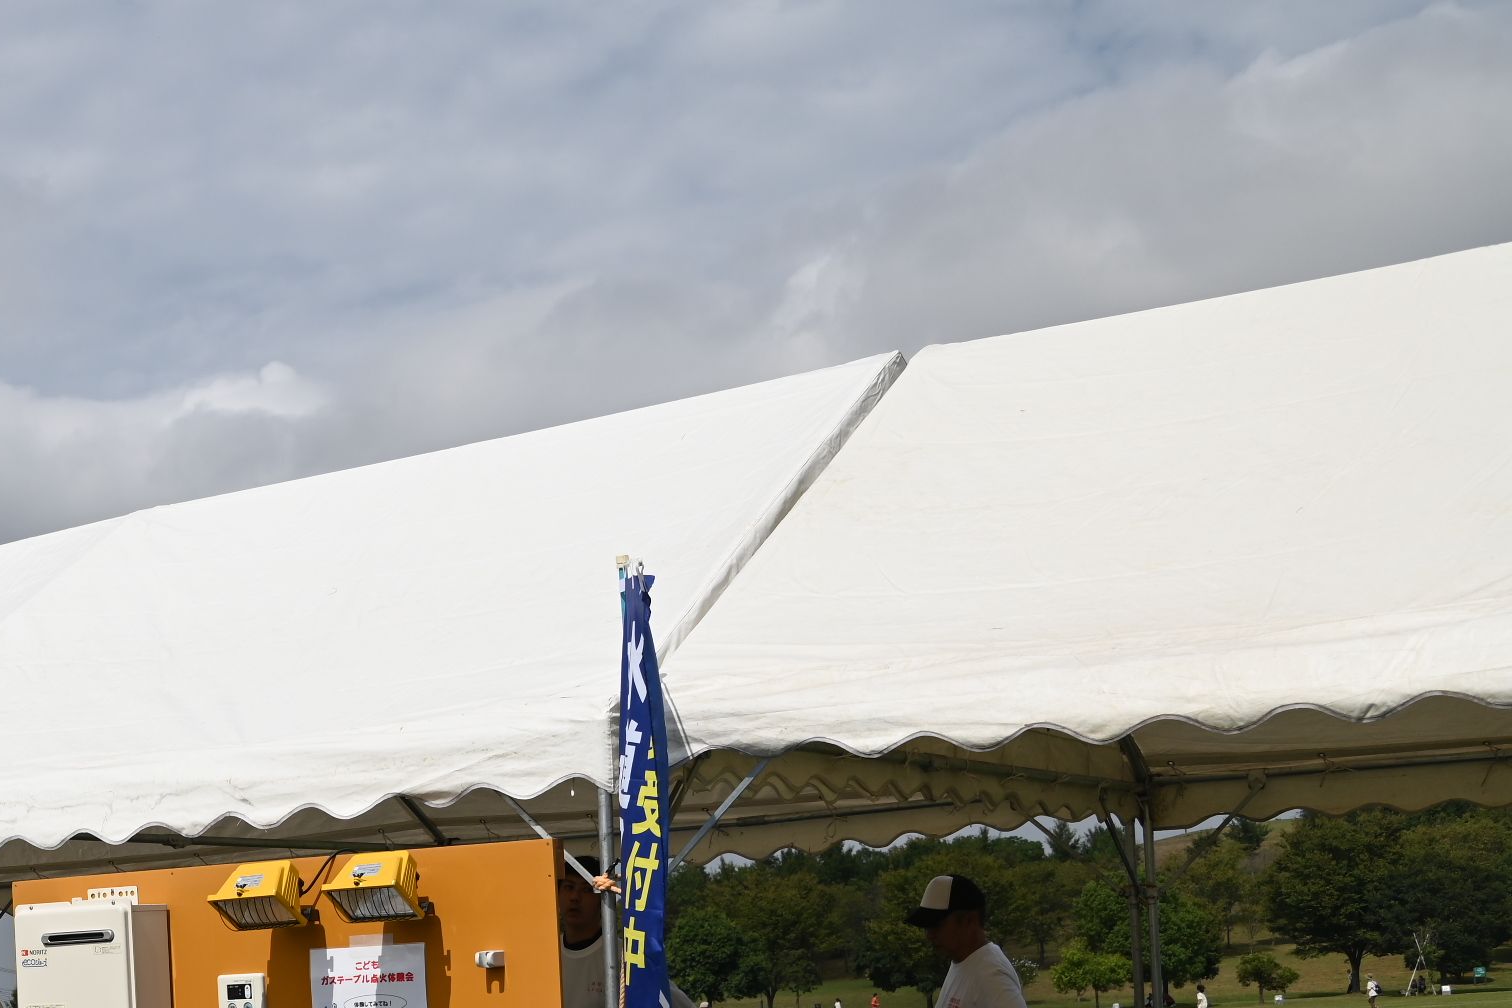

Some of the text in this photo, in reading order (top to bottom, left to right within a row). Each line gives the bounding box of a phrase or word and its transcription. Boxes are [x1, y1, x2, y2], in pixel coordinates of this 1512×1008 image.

[29, 949, 48, 957] NORITZ
[354, 960, 381, 971] こども
[321, 971, 415, 986] ガステーブル点火体験会
